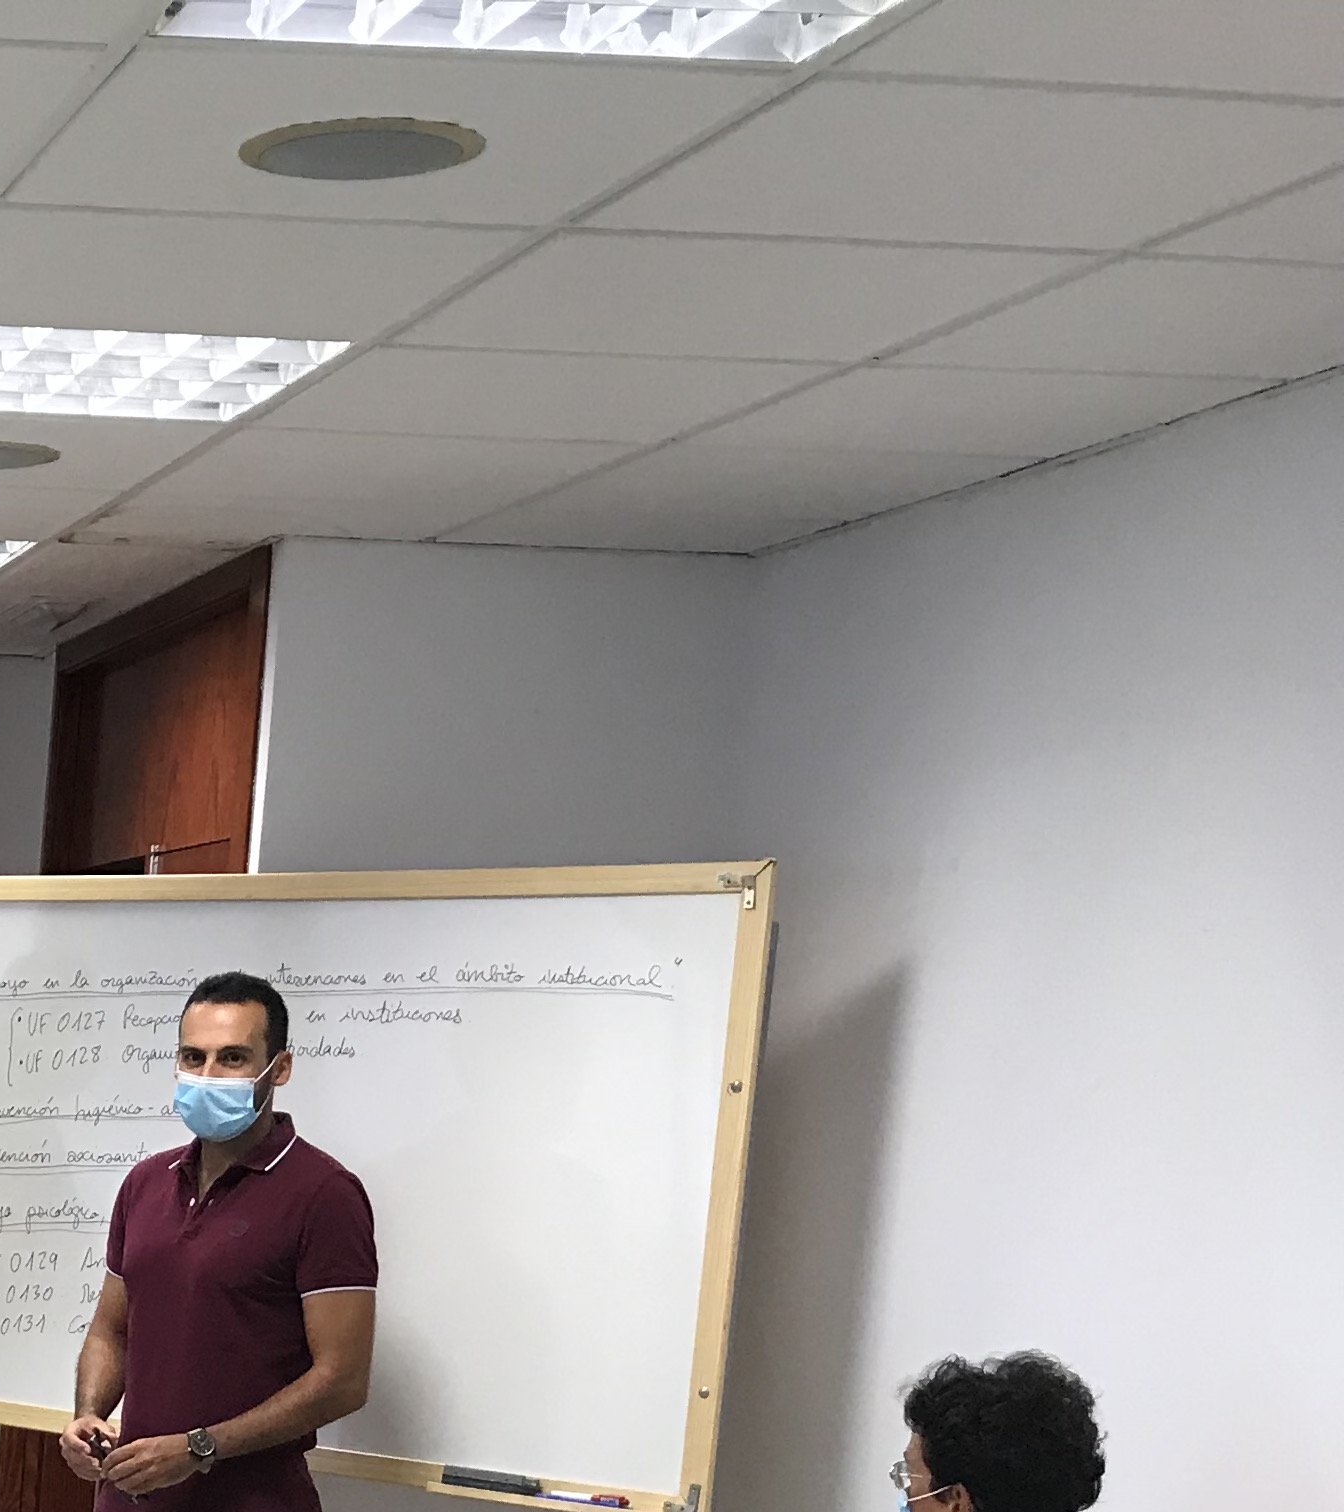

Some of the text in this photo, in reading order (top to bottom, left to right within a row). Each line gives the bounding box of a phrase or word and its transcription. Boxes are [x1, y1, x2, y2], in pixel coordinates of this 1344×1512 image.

[42, 977, 61, 989] en
[76, 971, 90, 988] la
[100, 970, 198, 993] organización
[382, 972, 405, 983] en
[416, 966, 439, 982] el
[455, 962, 526, 984] ámbito
[56, 1010, 106, 1033] 0127
[123, 1003, 181, 1034] Recepcio
[305, 1011, 326, 1023] en
[51, 1046, 101, 1071] 0128
[122, 1045, 177, 1075] Organi
[10, 1251, 58, 1273] 0129
[6, 1283, 53, 1304] 0130
[0, 1313, 46, 1335] 0131
